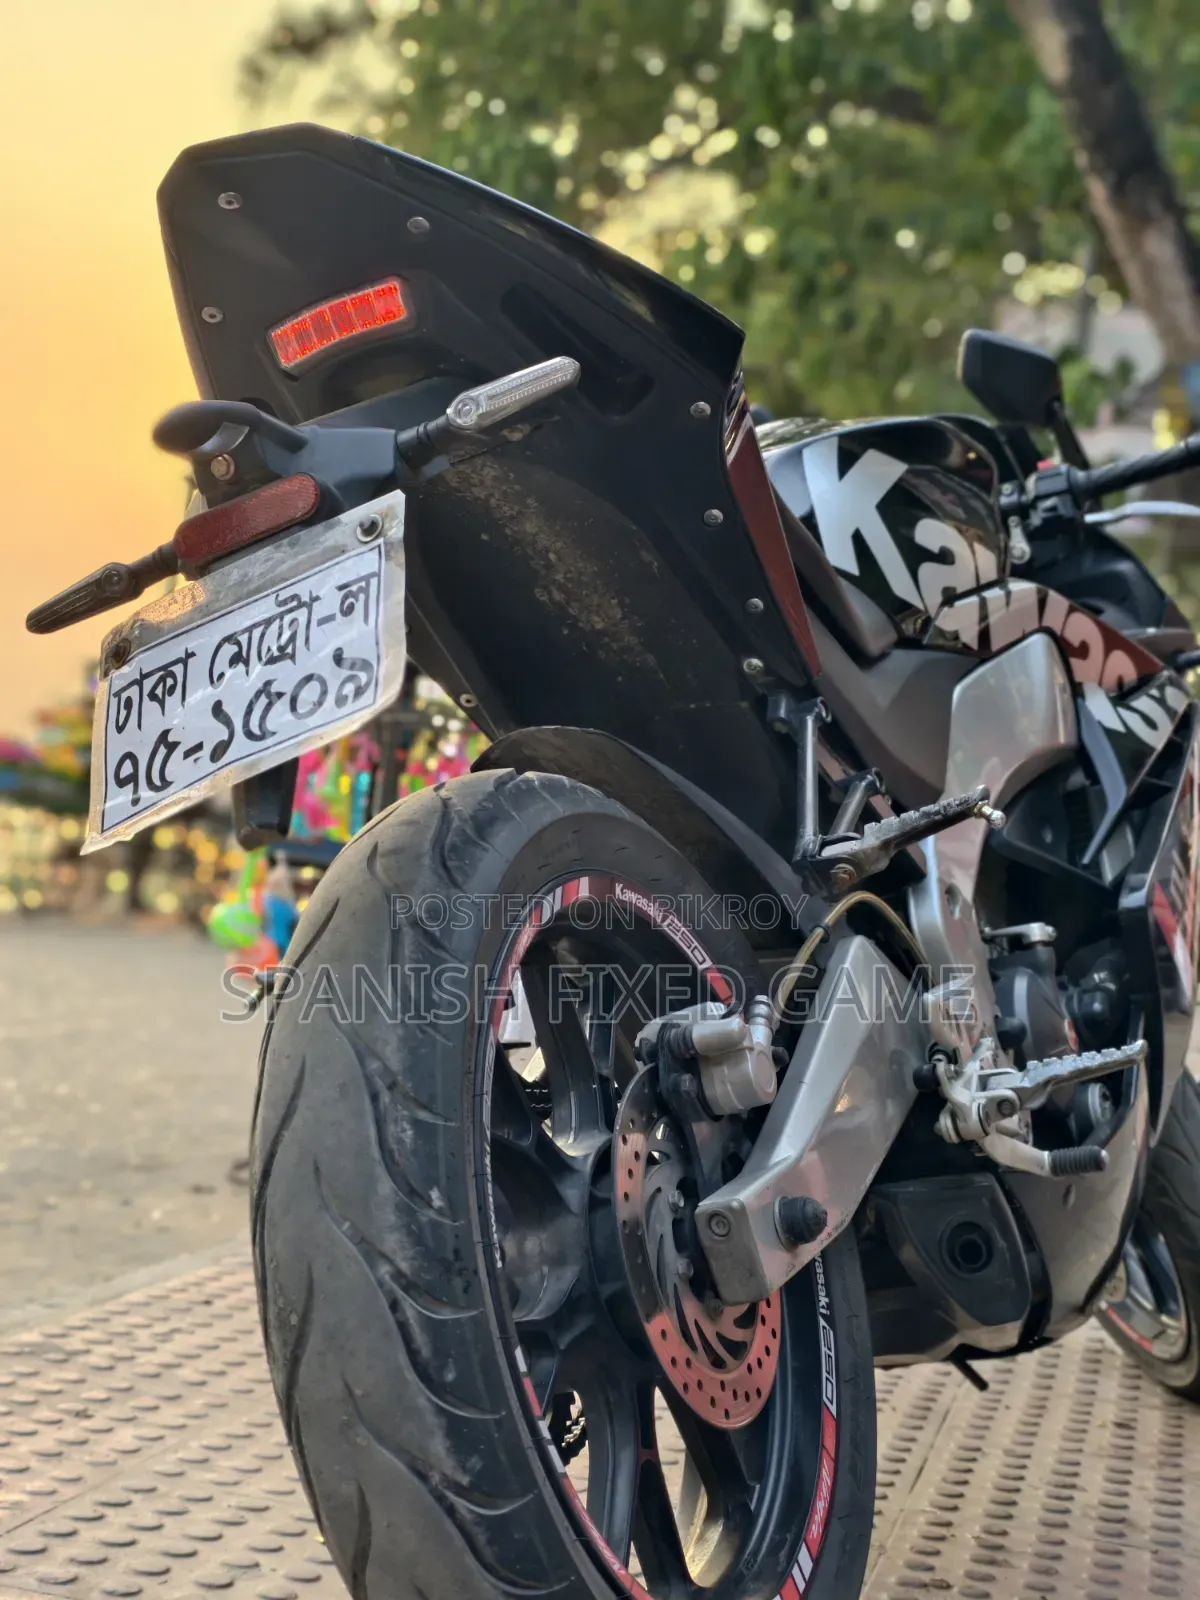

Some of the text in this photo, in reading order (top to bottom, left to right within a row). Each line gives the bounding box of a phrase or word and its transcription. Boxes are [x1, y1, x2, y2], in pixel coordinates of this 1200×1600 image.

[802, 436, 1190, 749] Kawas
[112, 647, 197, 735] ঢাকা
[113, 647, 374, 807] ৭৫-১৫০৯
[615, 883, 708, 966] Kawasaki 250
[820, 1323, 836, 1409] 250
